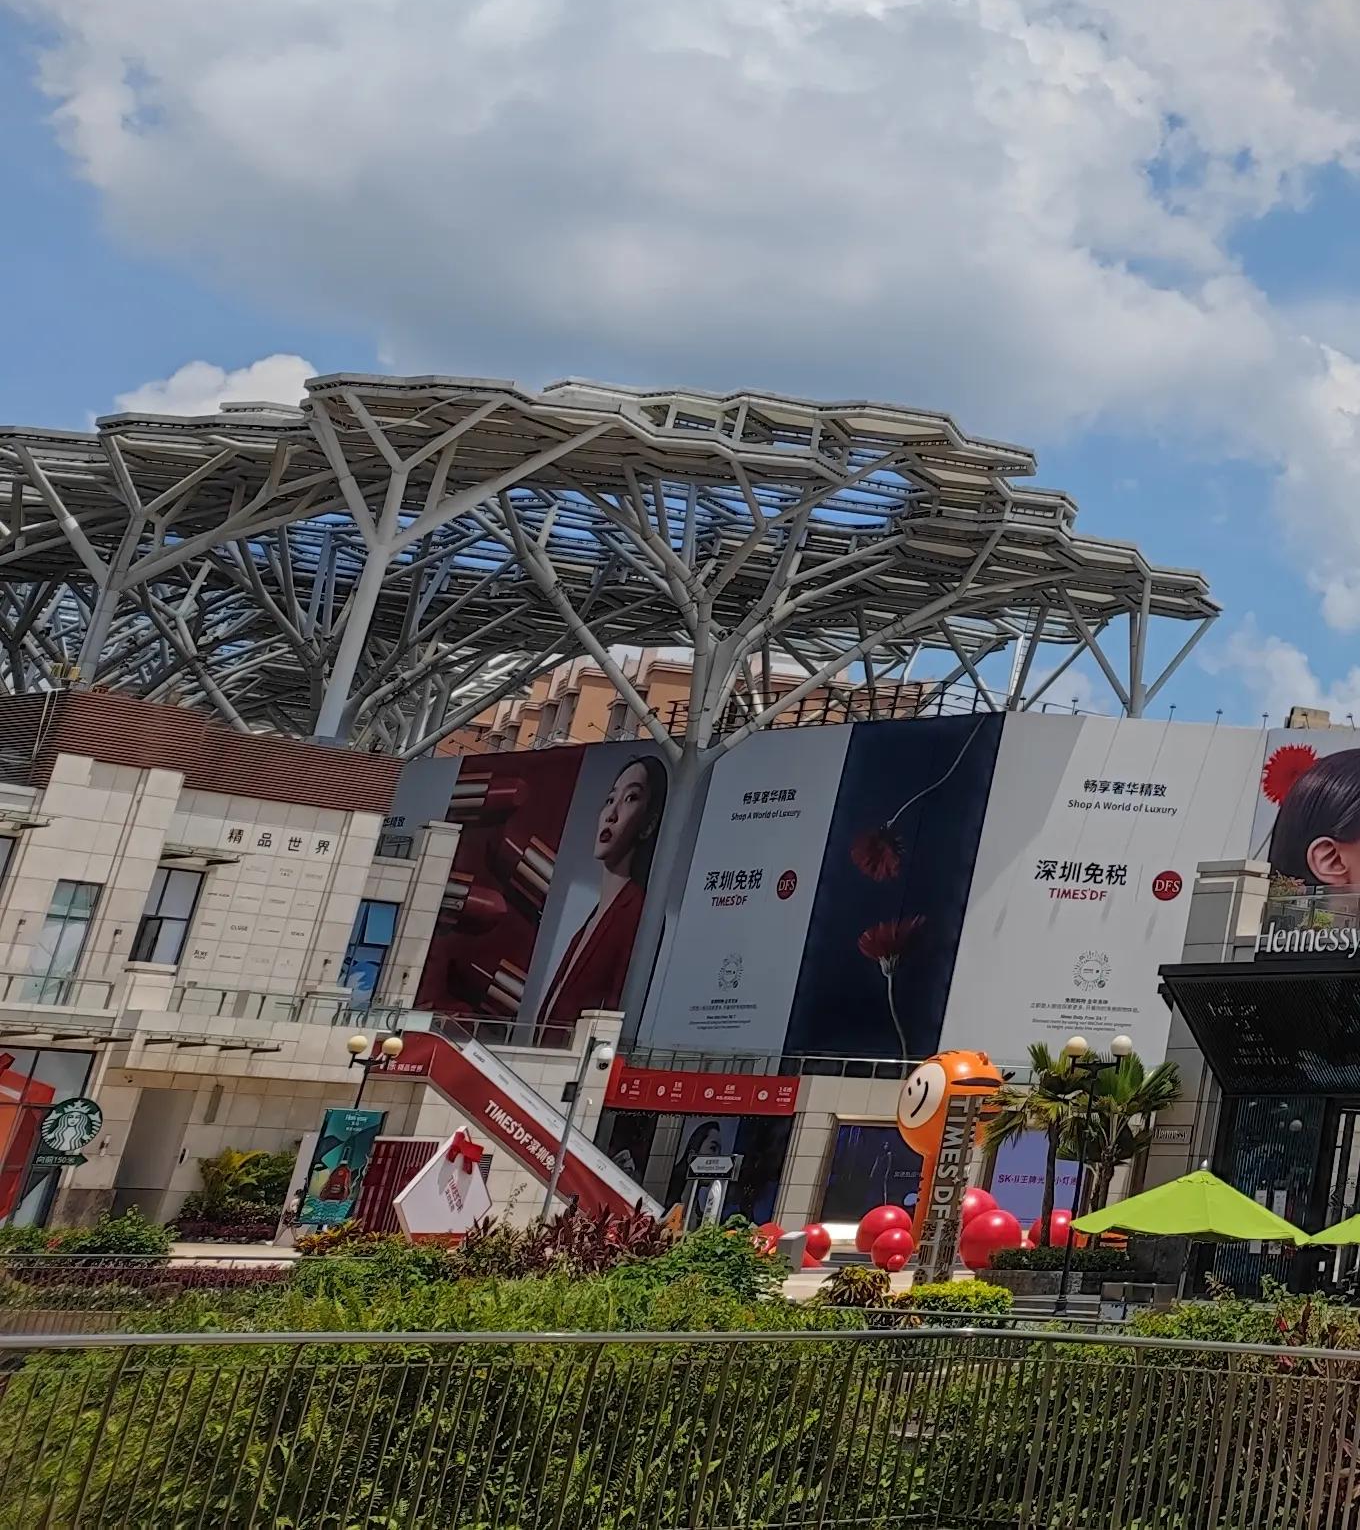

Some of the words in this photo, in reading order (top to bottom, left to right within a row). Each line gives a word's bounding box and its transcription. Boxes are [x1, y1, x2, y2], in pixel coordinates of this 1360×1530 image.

[1083, 779, 1168, 798] 畅享奢华精致
[753, 811, 770, 820] World
[779, 810, 801, 819] Luxury
[1067, 799, 1092, 811] Shop
[1094, 801, 1101, 810] A
[1103, 802, 1131, 812] World
[1133, 803, 1143, 812] of
[1145, 804, 1178, 816] Luxury
[228, 828, 331, 856] 精品世界
[703, 868, 764, 891] 深圳免税
[1034, 859, 1128, 886] 深圳免税
[777, 878, 797, 892] DFS
[1154, 879, 1181, 893] DFS
[1154, 1126, 1189, 1142] Hennessy
[526, 1139, 565, 1174] 深圳免
